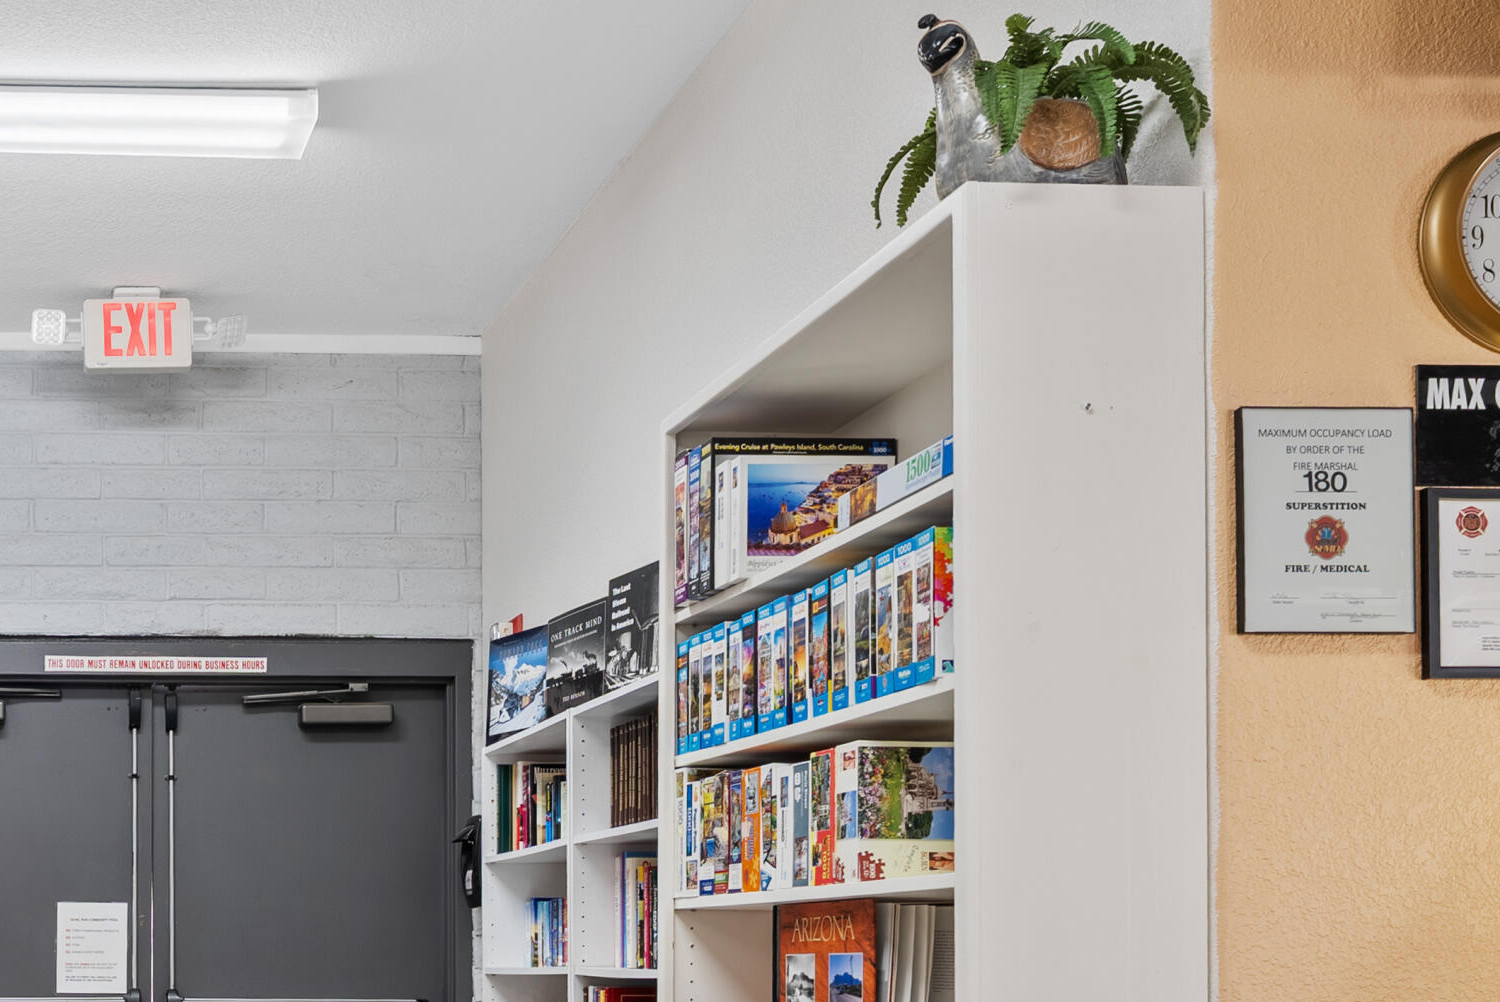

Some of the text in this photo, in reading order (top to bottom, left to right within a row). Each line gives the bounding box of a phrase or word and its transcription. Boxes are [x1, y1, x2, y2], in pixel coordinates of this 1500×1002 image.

[1471, 225, 1484, 249] 9
[1482, 258, 1495, 283] 8
[102, 302, 177, 357] EXIT
[1426, 377, 1486, 410] MAX
[1258, 429, 1392, 439] MAXIMUM OCCUPANCY LOAD
[714, 443, 864, 453] Evening Cruise at Pawleys Island, South Carolina
[1286, 445, 1365, 455] BY ORDER OF THE
[905, 450, 931, 483] 1500
[1293, 462, 1358, 471] FIRE MARSHAL
[1302, 470, 1347, 493] 180
[1285, 502, 1367, 511] SUPERSTITION
[897, 542, 912, 555] 1000
[877, 554, 891, 566] 1000
[1284, 565, 1310, 573] FIRE
[1319, 565, 1370, 573] MEDICAL
[550, 616, 603, 643] ONE TRACK MIND
[47, 658, 265, 670] THIS DOOR MUST REMAIN UNLOCKED DURING BUSINESS HOURS
[792, 915, 855, 943] ARIZONA
